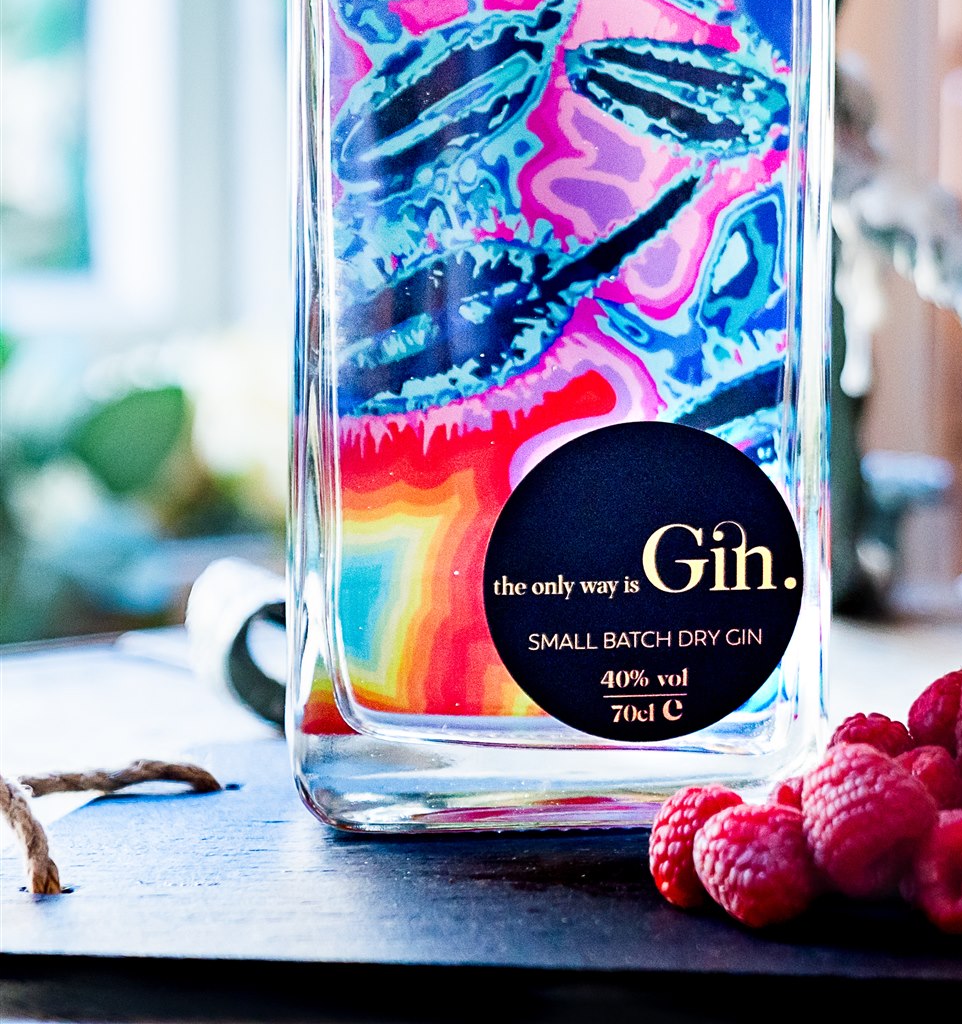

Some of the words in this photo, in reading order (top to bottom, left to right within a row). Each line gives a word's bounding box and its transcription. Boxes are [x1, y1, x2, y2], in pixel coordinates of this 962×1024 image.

[493, 575, 527, 596] the
[531, 574, 575, 600] only
[579, 580, 619, 599] way
[624, 575, 640, 594] is
[642, 520, 798, 593] Gin.
[528, 633, 598, 651] SMALL
[603, 630, 671, 649] BATCH
[678, 628, 721, 648] DRY
[725, 627, 762, 645] GIN
[600, 669, 649, 689] 40%
[657, 667, 688, 688] vol
[611, 703, 655, 723] 70cl
